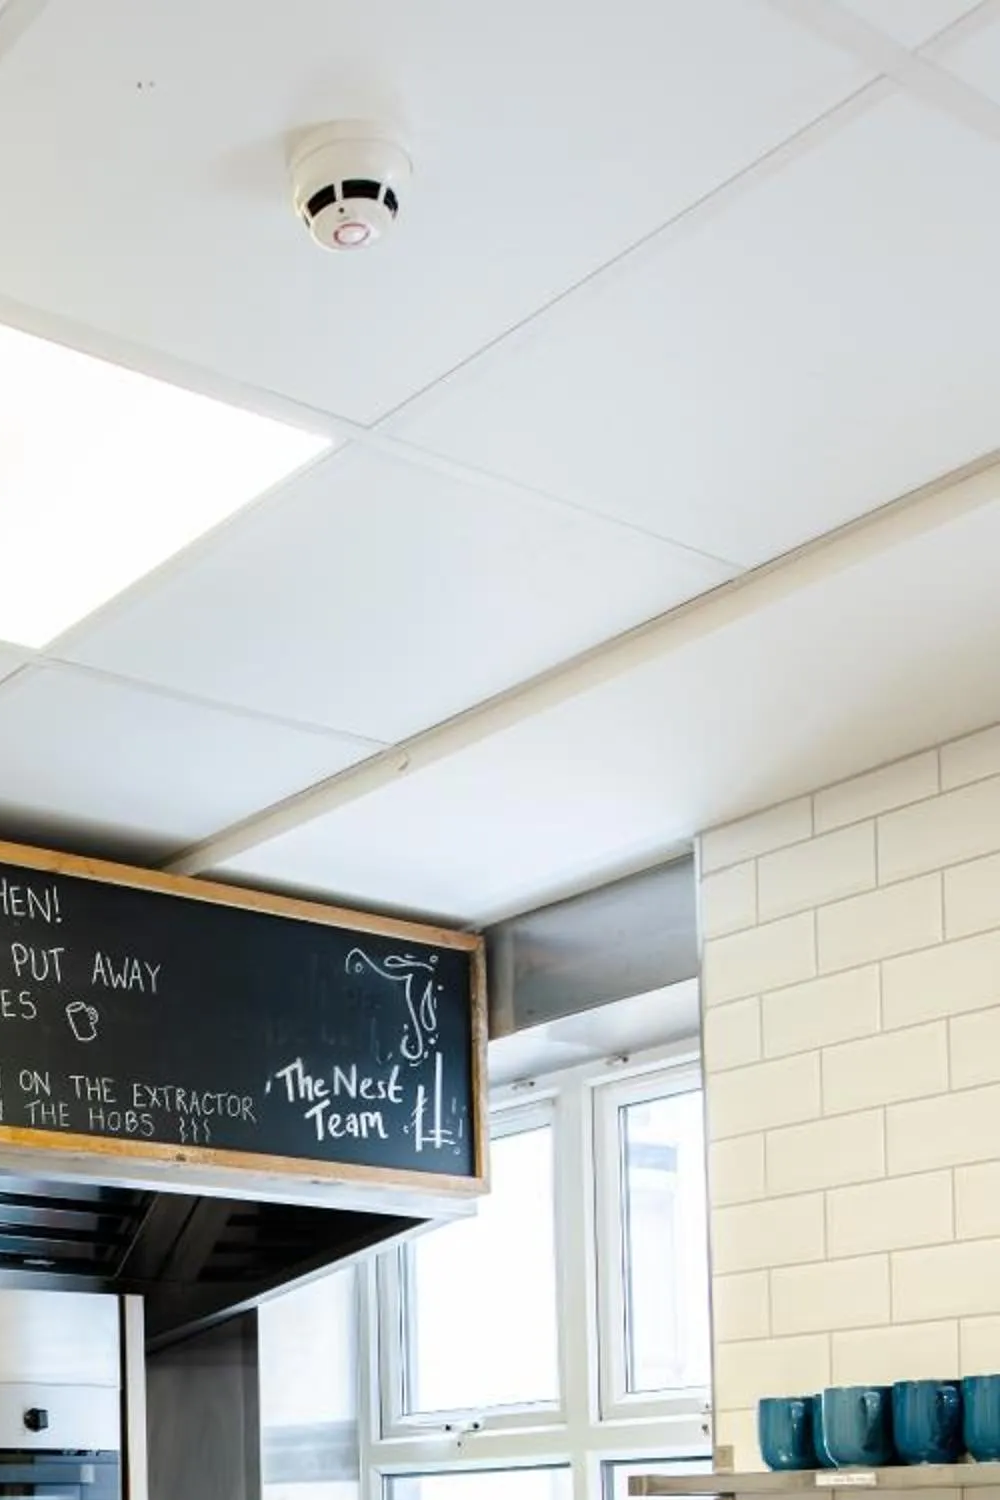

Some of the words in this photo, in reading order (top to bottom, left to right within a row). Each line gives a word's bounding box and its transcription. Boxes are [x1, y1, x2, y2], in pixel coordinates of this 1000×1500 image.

[11, 942, 65, 983] PUT
[91, 951, 161, 994] AWAY
[18, 1069, 51, 1096] ON
[69, 1075, 117, 1103] THE
[132, 1083, 258, 1124] EXTRACTOR
[274, 1056, 331, 1103] The
[332, 1063, 404, 1103] Nest
[24, 1100, 71, 1128] THE
[88, 1107, 156, 1138] HOBS
[304, 1098, 389, 1142] Team
